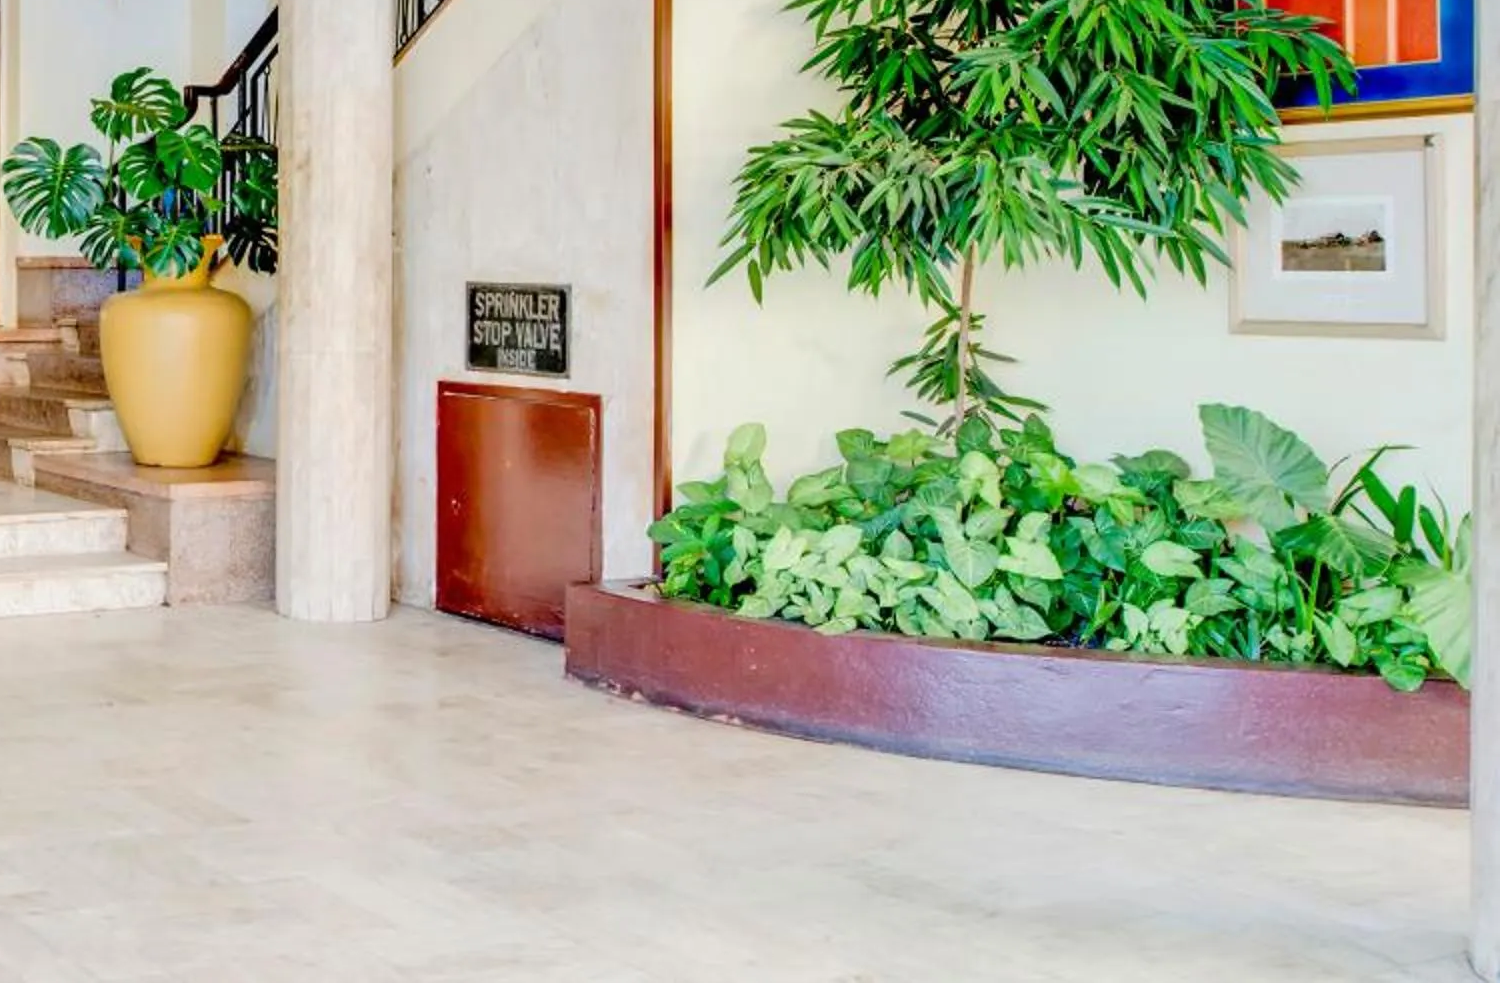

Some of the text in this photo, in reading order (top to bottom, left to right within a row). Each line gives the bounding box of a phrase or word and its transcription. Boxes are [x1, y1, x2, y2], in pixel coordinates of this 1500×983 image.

[474, 291, 560, 320] SPRINKLER
[473, 319, 561, 351] STOP VALVE
[497, 349, 536, 368] INSIDE
